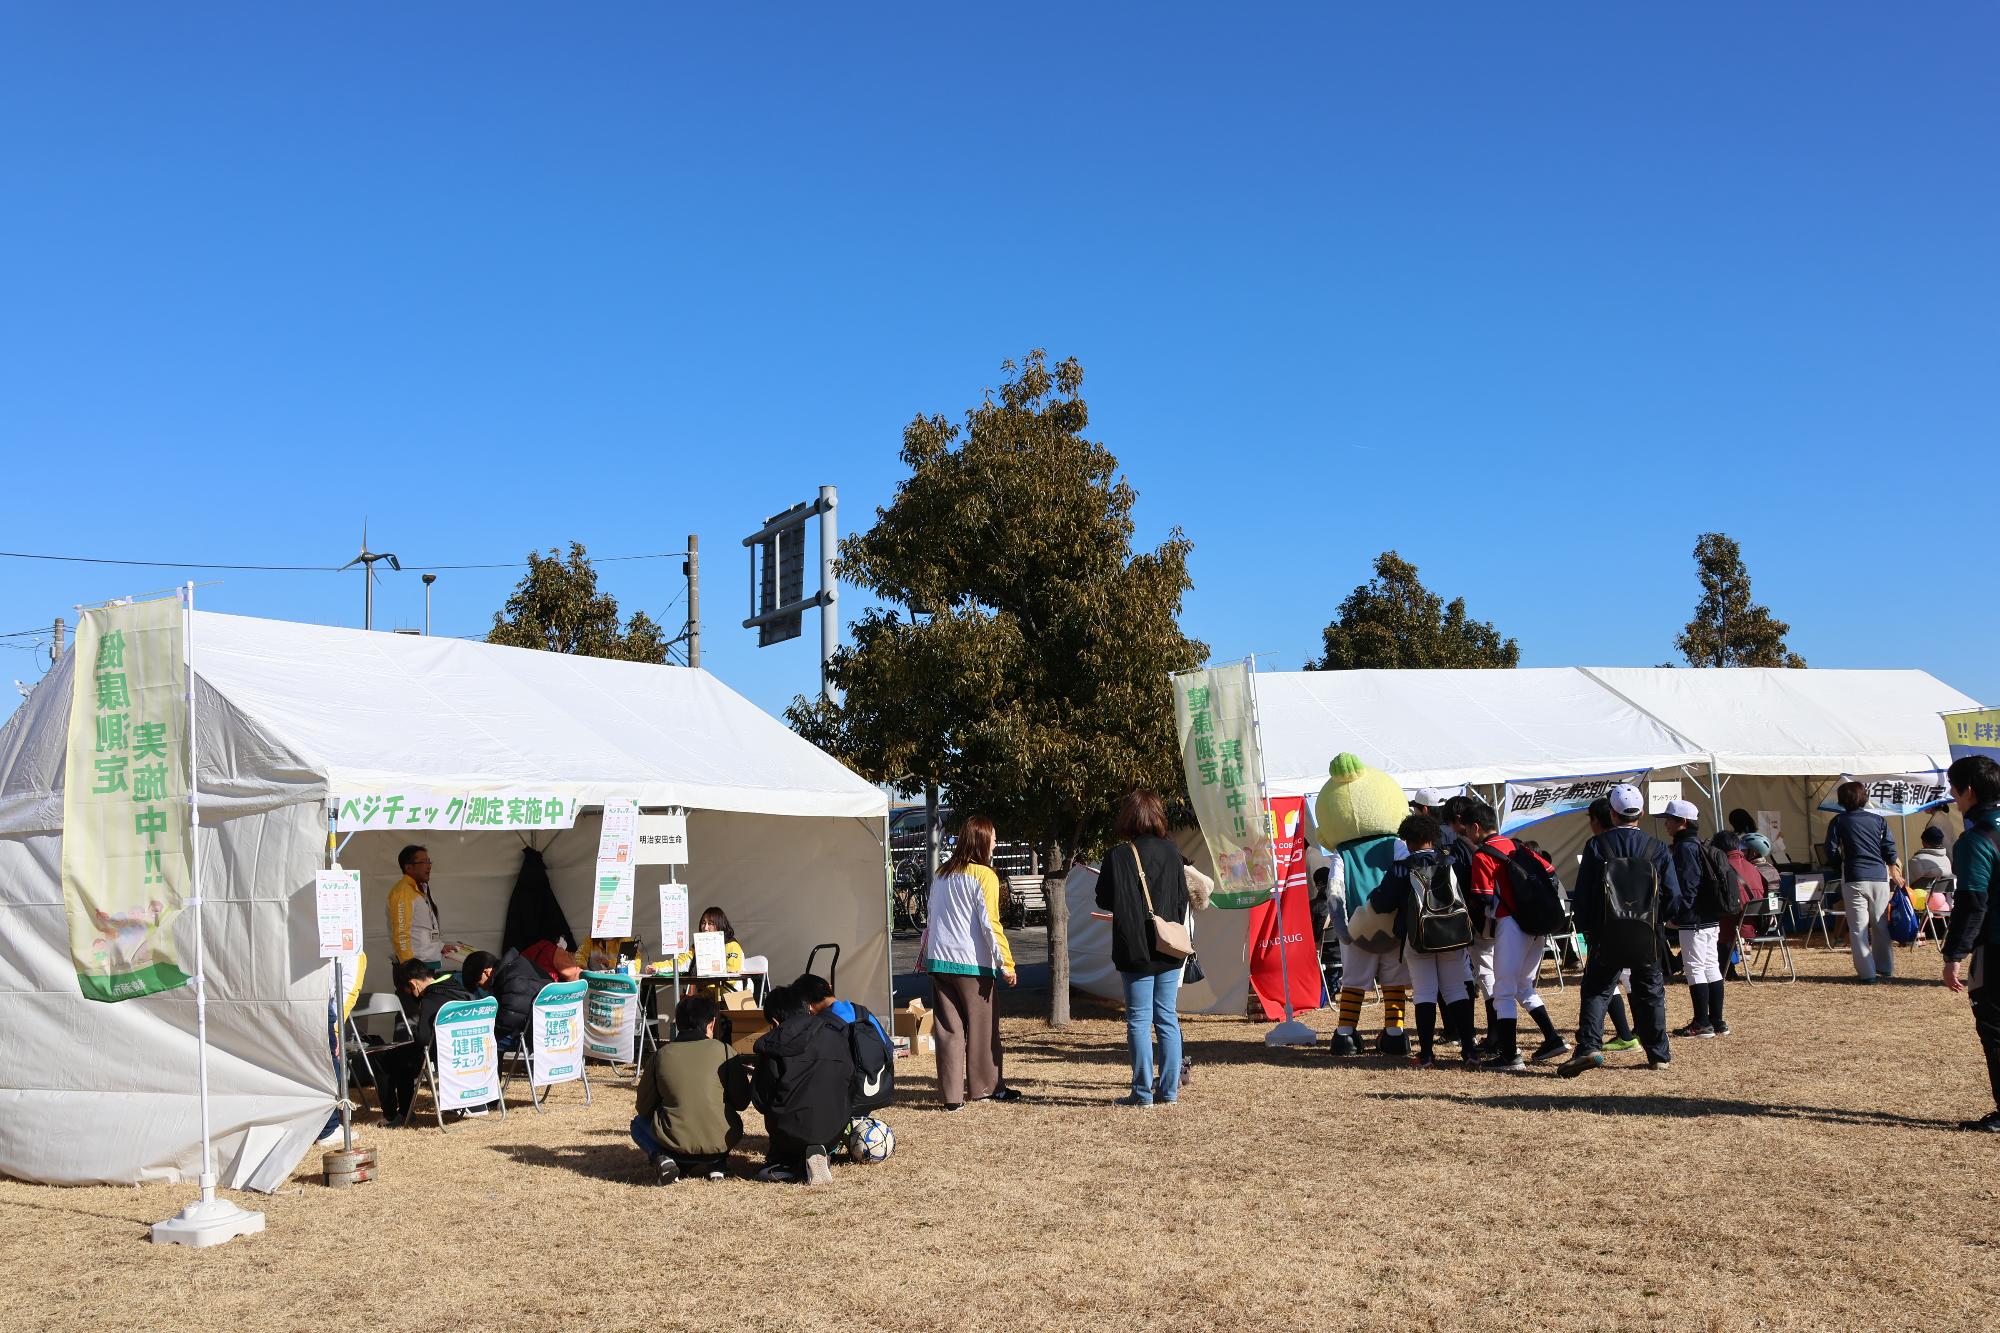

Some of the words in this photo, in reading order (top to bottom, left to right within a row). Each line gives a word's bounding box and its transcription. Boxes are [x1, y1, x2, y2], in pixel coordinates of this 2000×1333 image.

[639, 835, 682, 845] 明治安田生命
[545, 1018, 570, 1036] 健康
[451, 1037, 484, 1056] 健康
[451, 1054, 485, 1069] チェック
